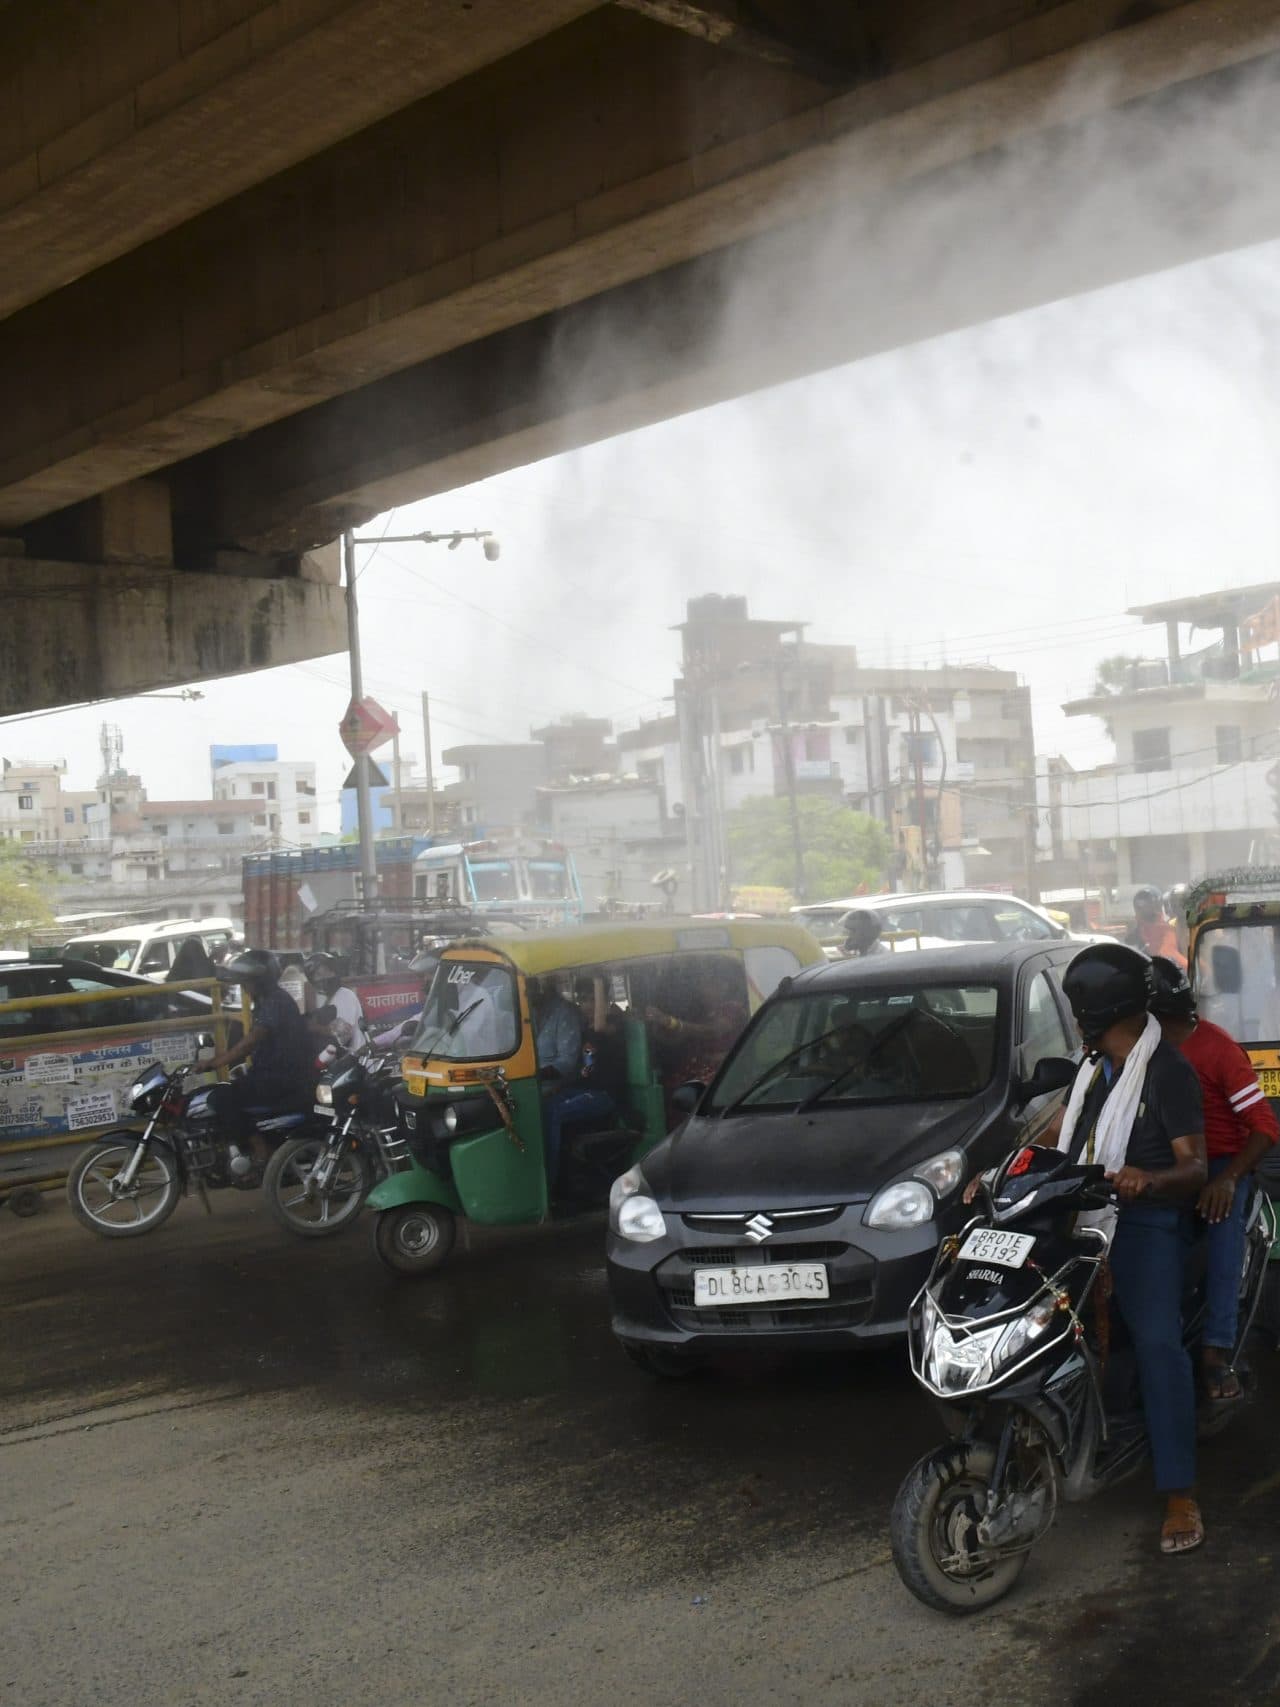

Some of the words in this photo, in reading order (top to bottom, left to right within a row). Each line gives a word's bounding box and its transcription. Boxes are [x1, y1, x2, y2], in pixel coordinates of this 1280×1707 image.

[447, 965, 475, 984] Uber
[978, 1231, 1026, 1249] BR01E
[971, 1244, 1019, 1263] K5192
